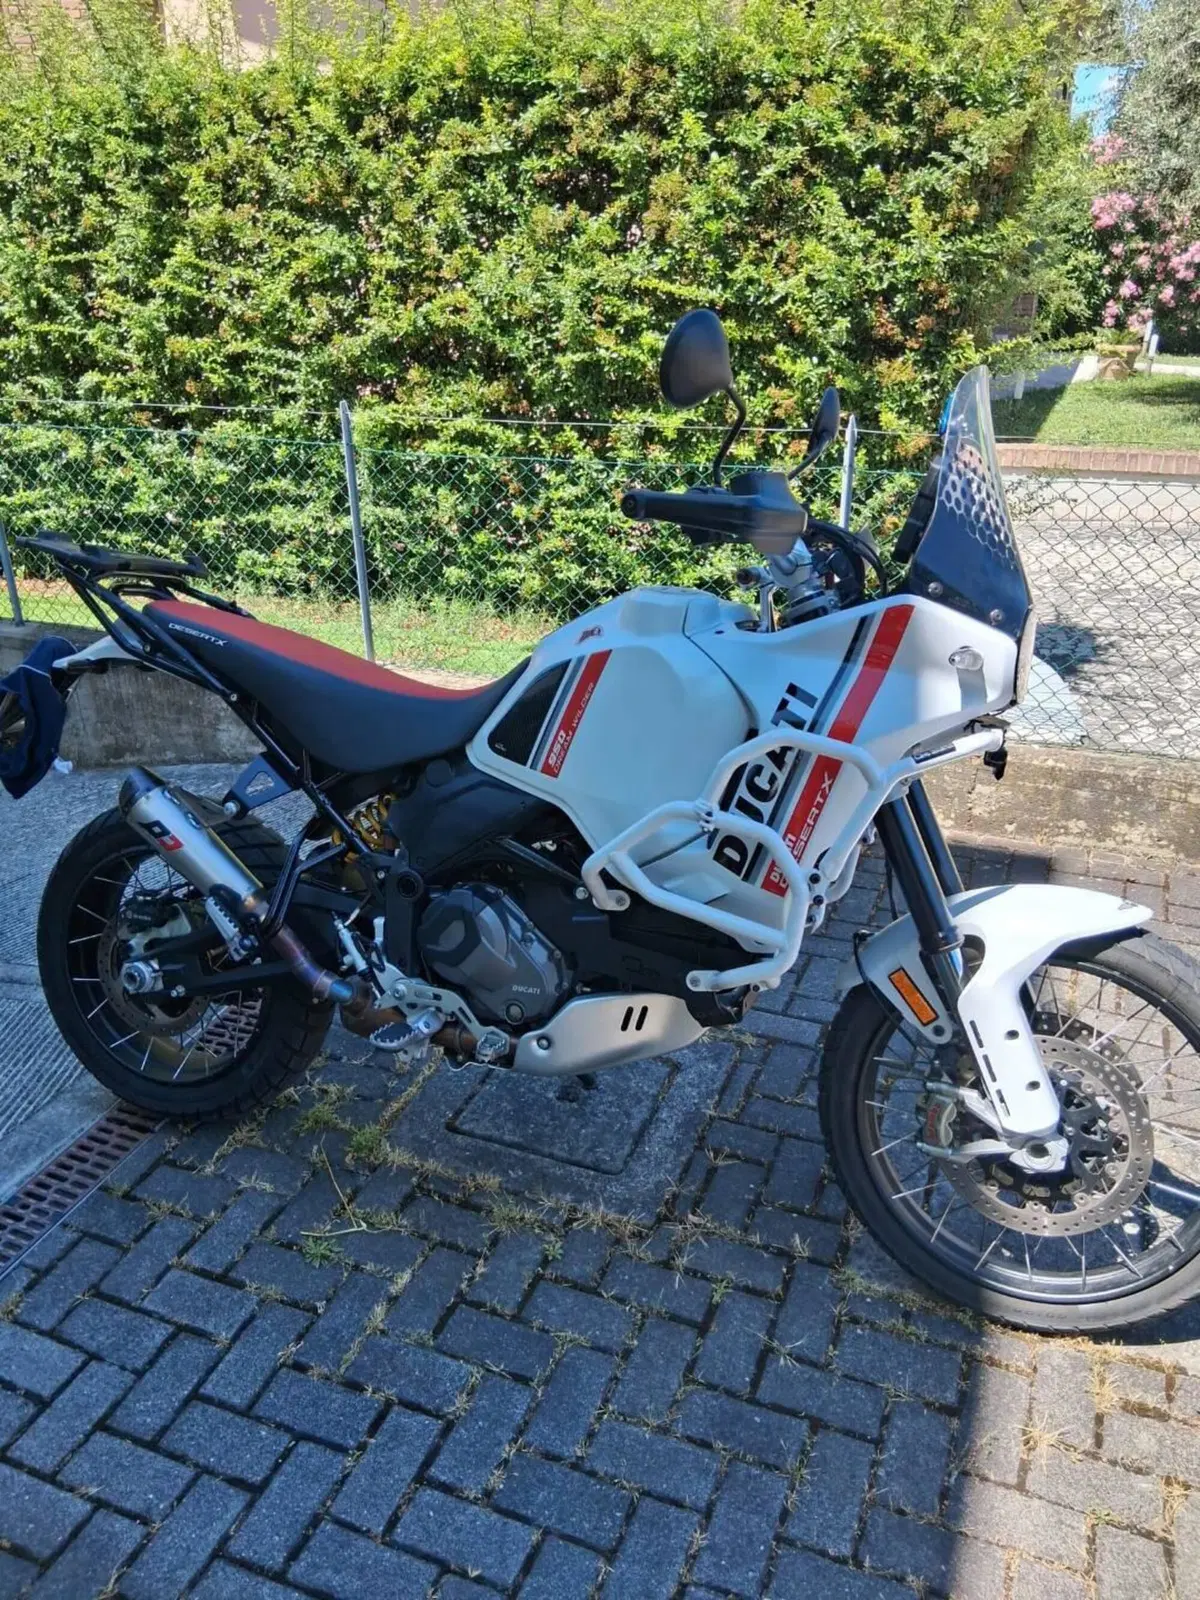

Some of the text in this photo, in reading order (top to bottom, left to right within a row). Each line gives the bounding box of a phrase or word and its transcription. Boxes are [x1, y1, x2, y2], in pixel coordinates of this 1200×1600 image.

[168, 622, 229, 647] DESERTX
[548, 728, 566, 768] 950
[512, 985, 540, 995] DUCATI
